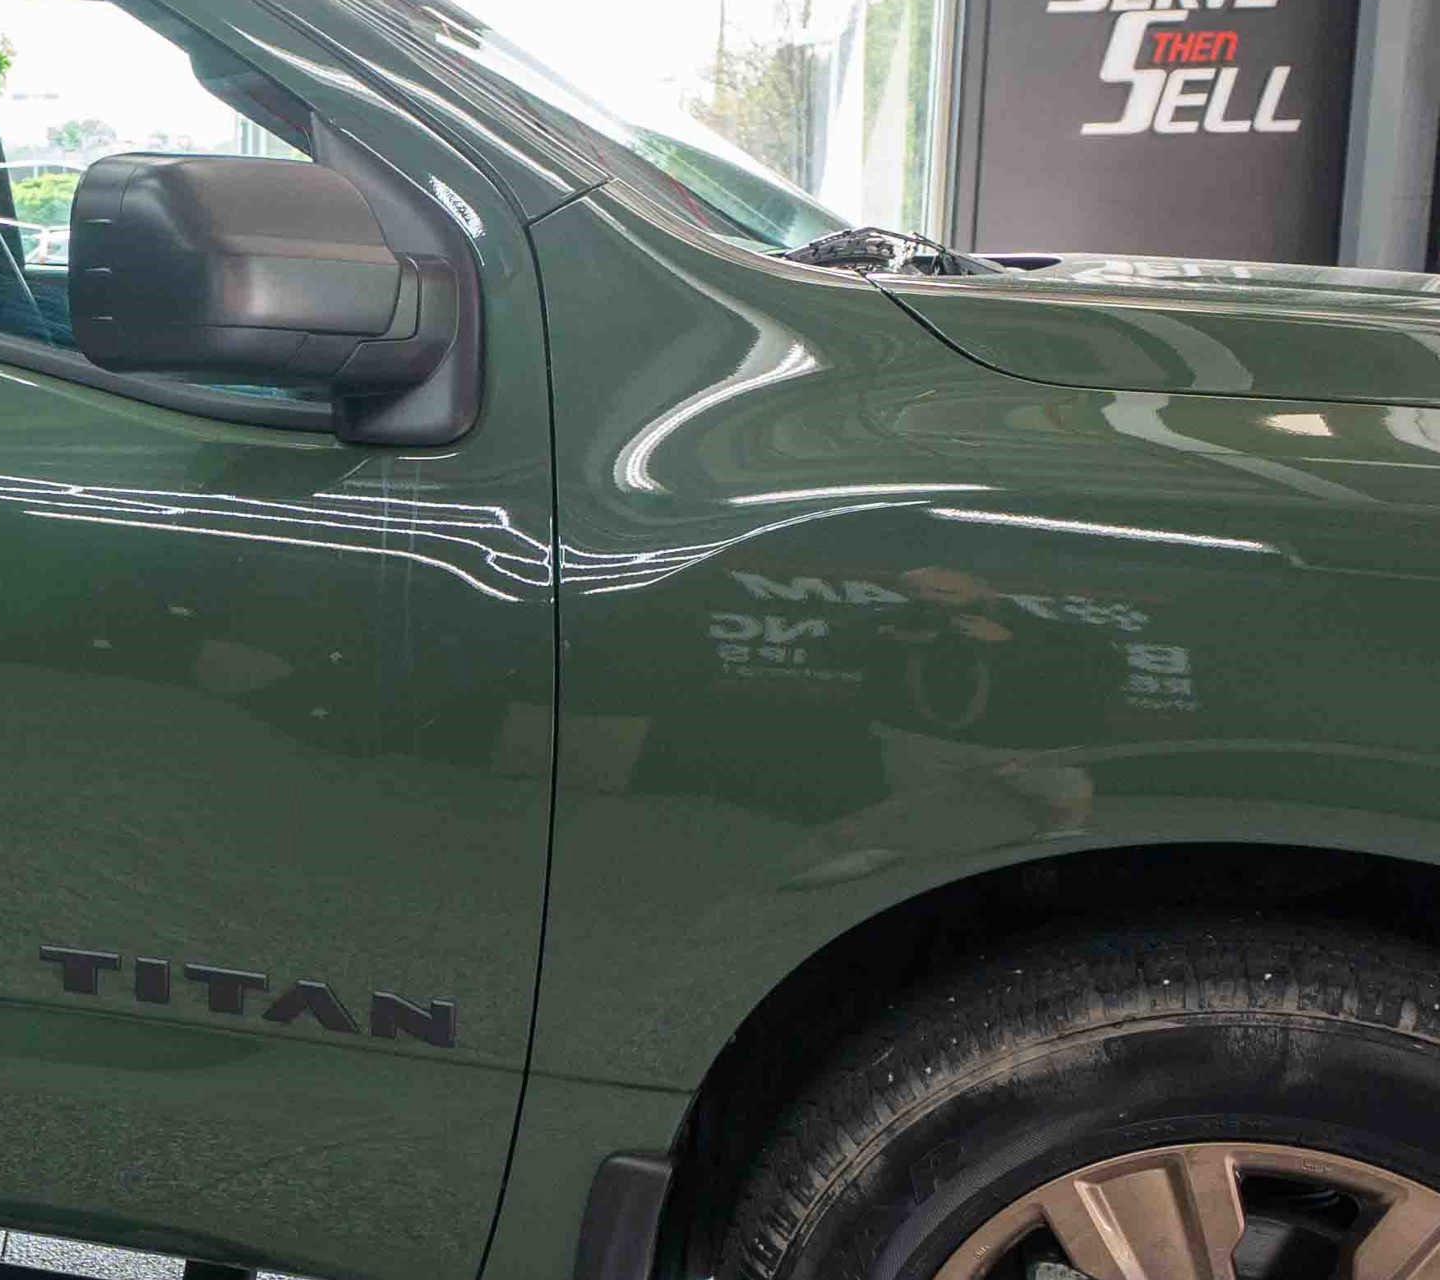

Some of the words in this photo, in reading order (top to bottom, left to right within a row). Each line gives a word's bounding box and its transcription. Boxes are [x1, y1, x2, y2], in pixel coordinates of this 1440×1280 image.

[1081, 10, 1302, 135] SELL
[1152, 29, 1239, 63] THEN
[38, 944, 457, 1049] TITAN
